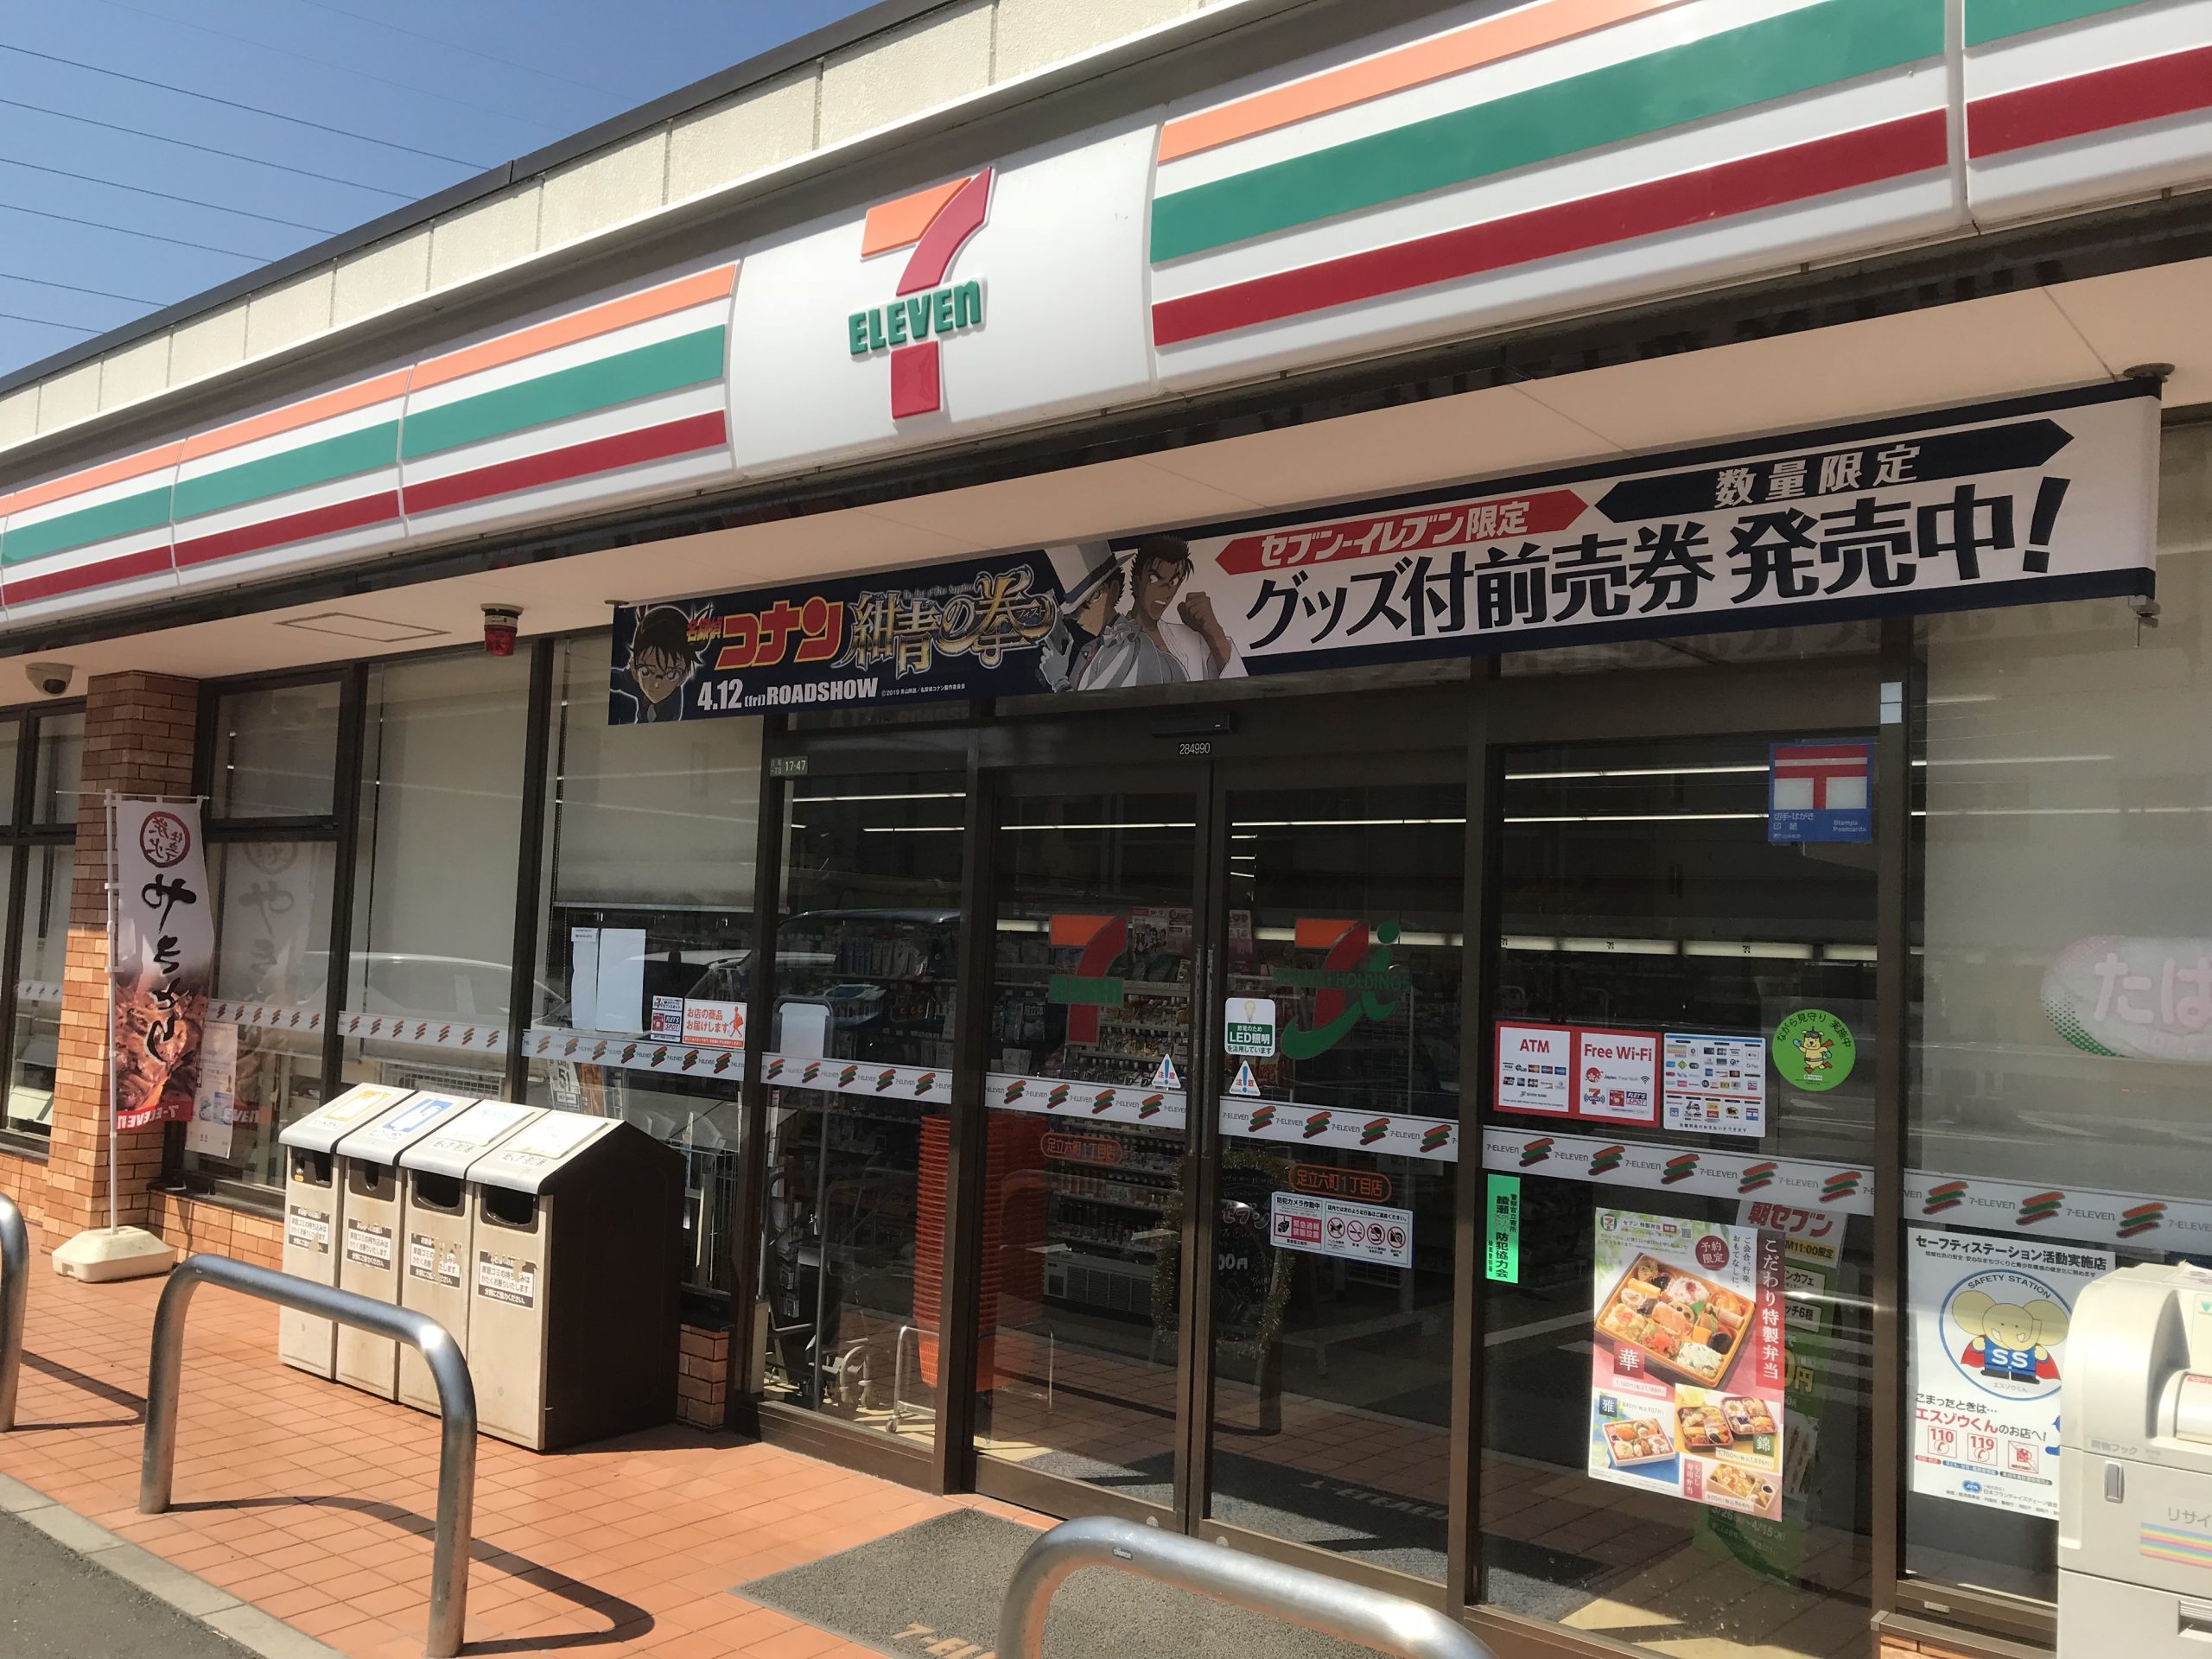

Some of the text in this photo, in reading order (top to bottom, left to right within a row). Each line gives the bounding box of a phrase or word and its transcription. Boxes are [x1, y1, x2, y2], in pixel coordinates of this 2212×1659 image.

[1713, 444, 1921, 510] 数量限定
[1246, 520, 1715, 650] グッズ付前売券
[830, 564, 1057, 680] 紺青の拳
[714, 596, 844, 671] コナン
[697, 678, 743, 711] 4.12
[766, 677, 878, 705] ROADSHOW
[1179, 742, 1211, 755] 284990
[785, 760, 806, 772] 17-47
[687, 1007, 723, 1020] お店の商品
[1230, 1031, 1270, 1045] LED照明
[1520, 1039, 1550, 1053] ATM
[1227, 1046, 1272, 1055] を活用しています
[1585, 1044, 1652, 1062] Free Wi-Fi
[1276, 1197, 1320, 1210] 防犯カメラ作動中
[1747, 1201, 1834, 1237] 朝セブン
[1700, 1241, 1722, 1252] 予約
[1916, 1235, 2107, 1271] セーフティステーション活動実施店
[1702, 1253, 1725, 1264] 限定
[1967, 1274, 2052, 1300] SAFETY STATION
[1761, 1238, 1780, 1381] こだわり特製弁当
[1618, 1348, 1640, 1371] 華
[1602, 1399, 1615, 1413] 雅
[1756, 1435, 1770, 1452] 錦
[1930, 1428, 1955, 1443] 110
[1970, 1435, 1994, 1451] 119
